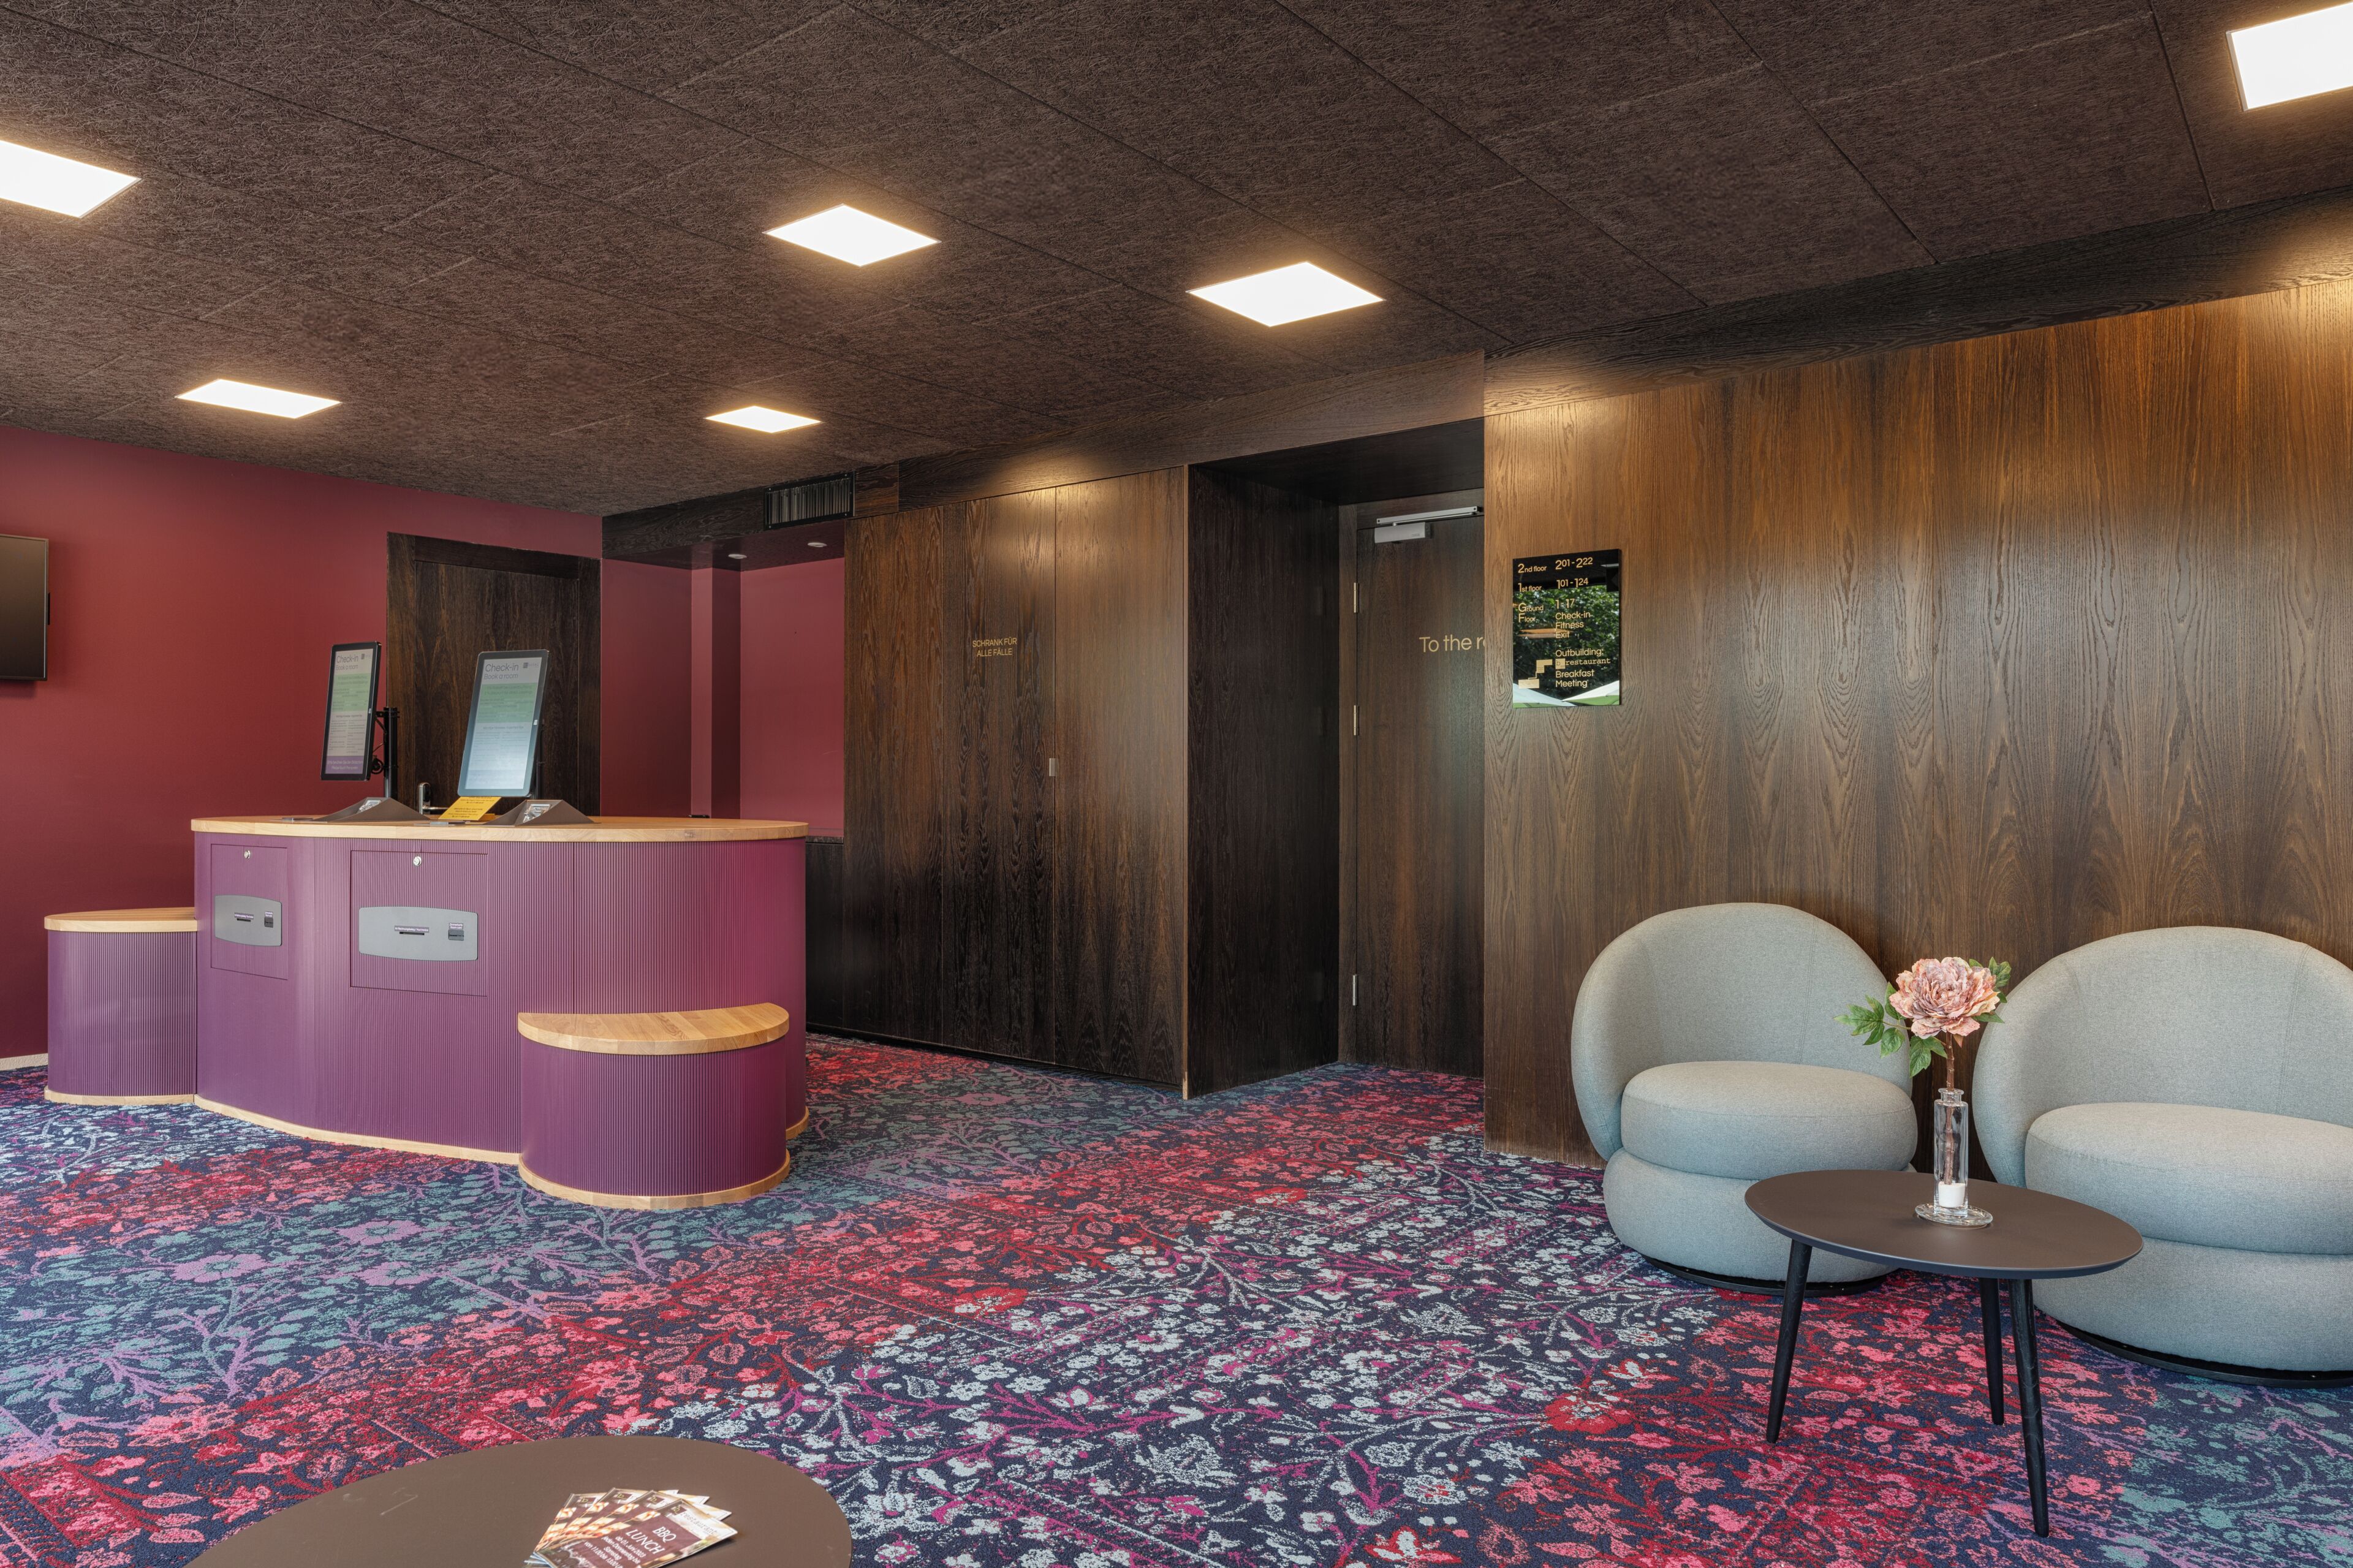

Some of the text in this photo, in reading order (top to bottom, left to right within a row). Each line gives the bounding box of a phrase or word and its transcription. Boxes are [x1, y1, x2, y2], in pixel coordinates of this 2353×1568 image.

[1518, 563, 1533, 574] 2nd
[1555, 559, 1570, 570] 201
[1576, 557, 1593, 568] 222
[1518, 583, 1527, 592] 1st
[1556, 579, 1569, 589] 101
[1574, 577, 1589, 588] 124
[1518, 602, 1544, 612] Ground
[1555, 599, 1559, 609] 1
[1566, 598, 1575, 608] 17
[1518, 613, 1536, 623] Floor
[1555, 611, 1591, 620] Check-in
[972, 637, 1017, 648] SCHRANK FÜR
[1419, 637, 1439, 653] To
[1443, 634, 1472, 651] the
[976, 648, 1012, 657] ALLE FÄLLE
[1555, 648, 1604, 657] Outbuilding:
[336, 654, 358, 663] Check-in
[485, 663, 519, 672] Check-in
[1555, 669, 1595, 678] Breakfast
[1555, 680, 1588, 688] Meeting
[680, 1512, 718, 1535] restaurant
[652, 1526, 676, 1543] BBQ
[626, 1529, 665, 1554] LUNCH
[603, 1546, 622, 1561] Samstag
